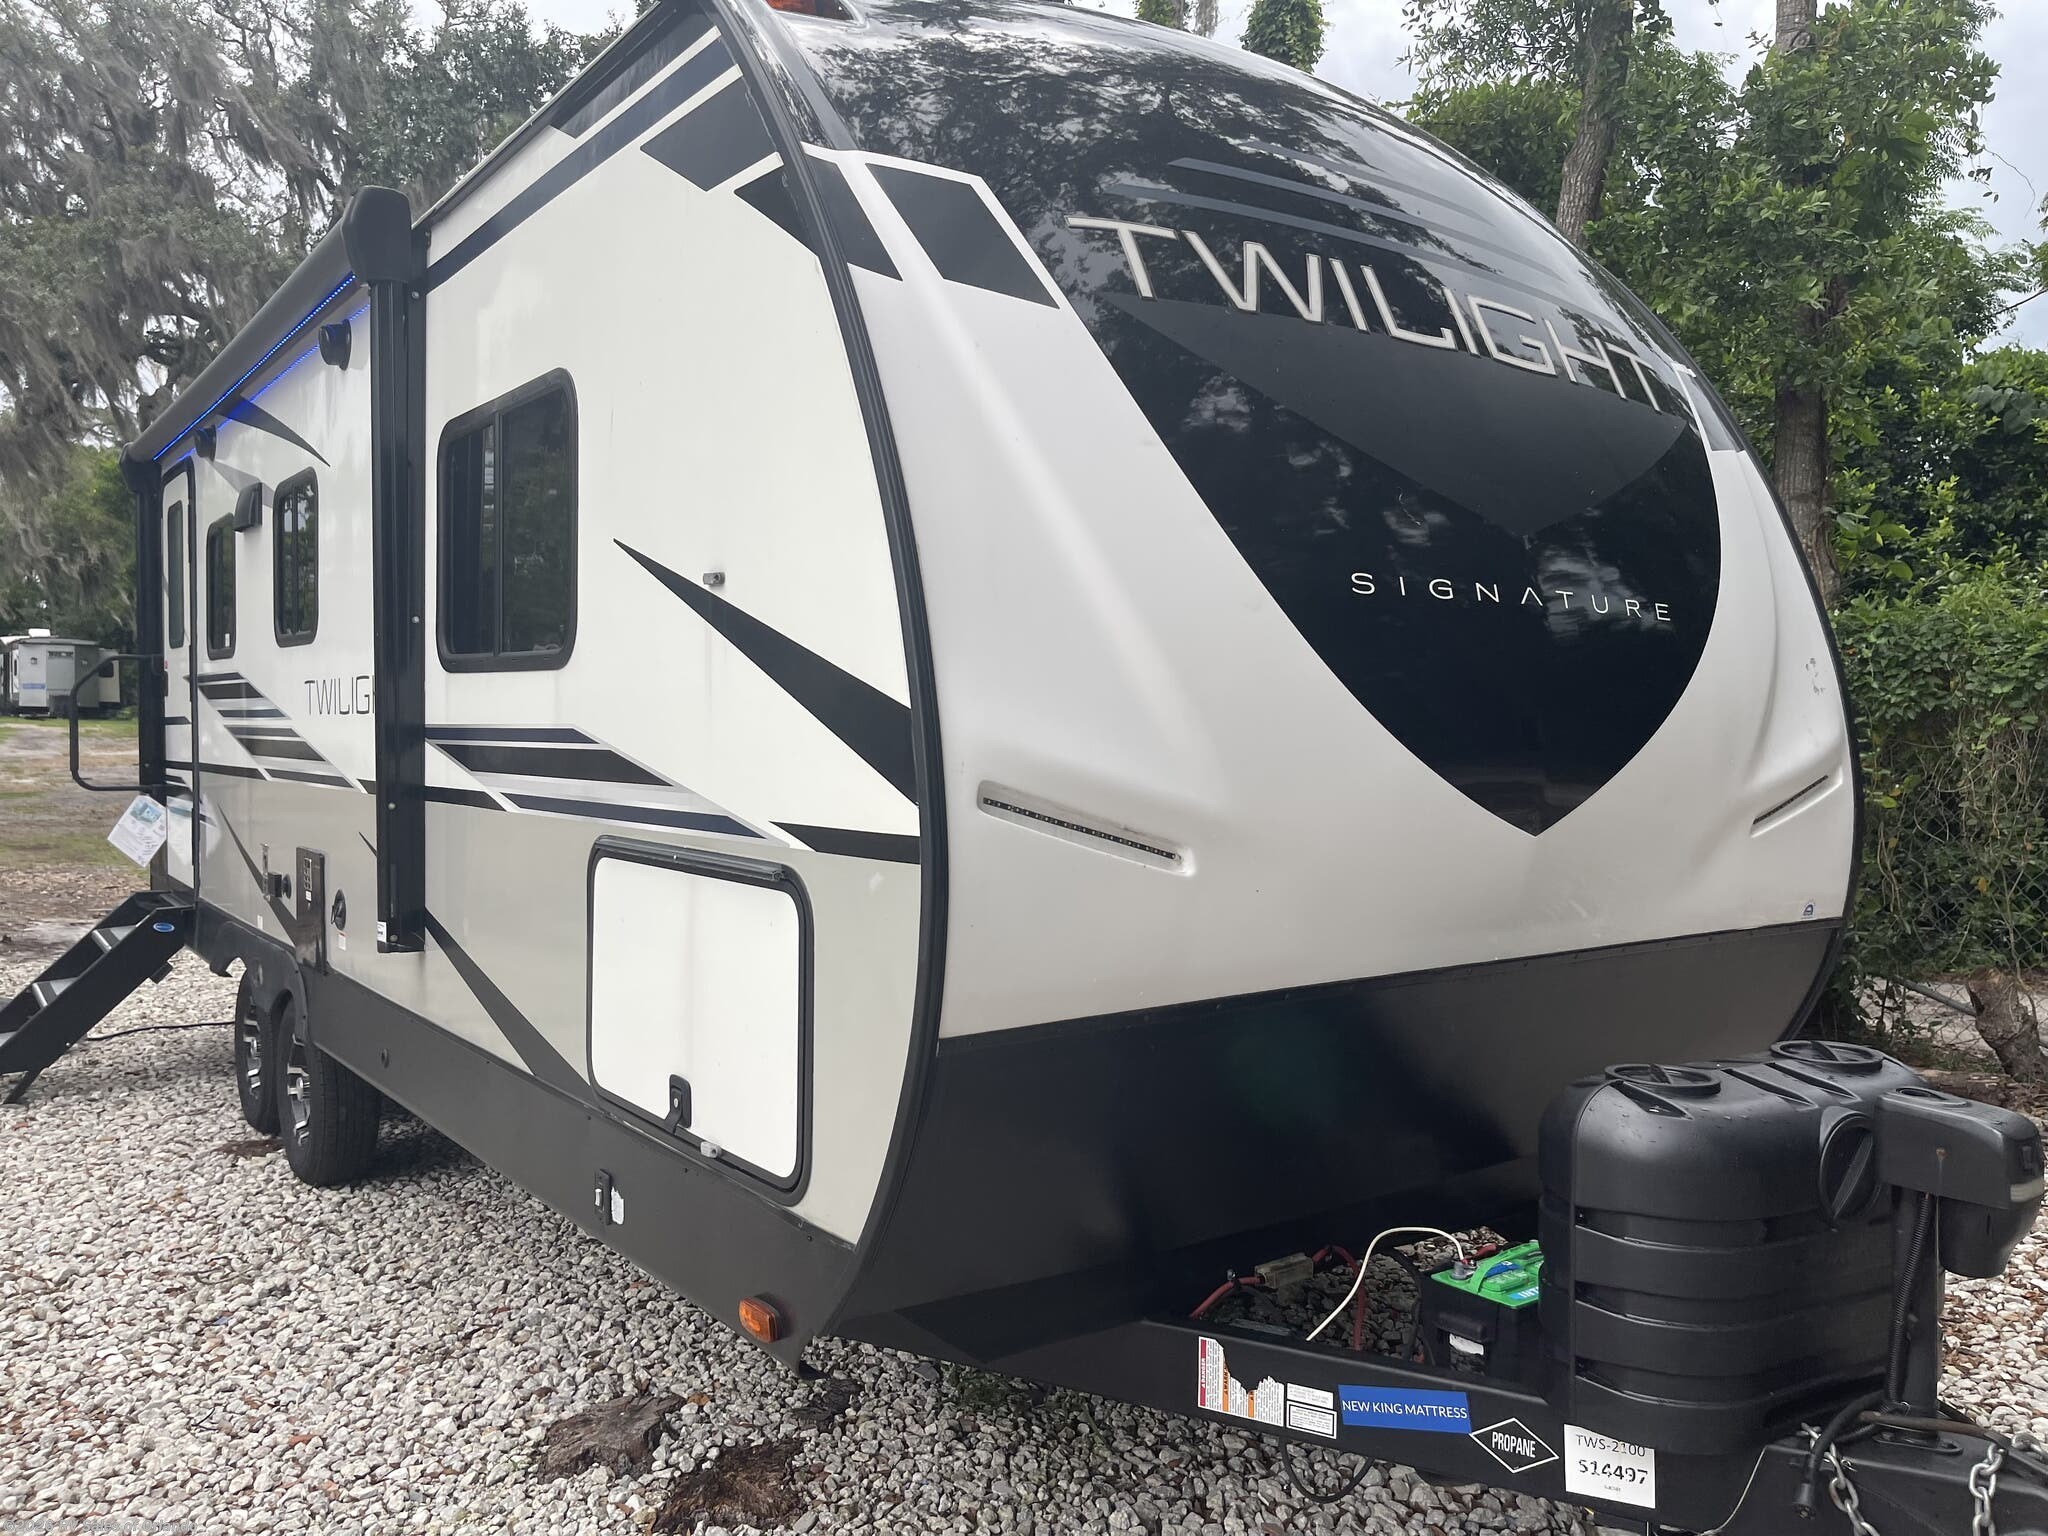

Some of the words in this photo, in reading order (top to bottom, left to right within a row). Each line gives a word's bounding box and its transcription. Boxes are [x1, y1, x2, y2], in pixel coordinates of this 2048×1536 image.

[1065, 215, 1662, 413] TWILIGHT
[1351, 573, 1671, 621] SIGNATURE
[304, 675, 375, 715] TWILIG
[1342, 1400, 1370, 1412] NEW
[1372, 1402, 1403, 1415] KING
[1405, 1404, 1468, 1419] MATTRESS
[1491, 1431, 1536, 1458] PROPANE
